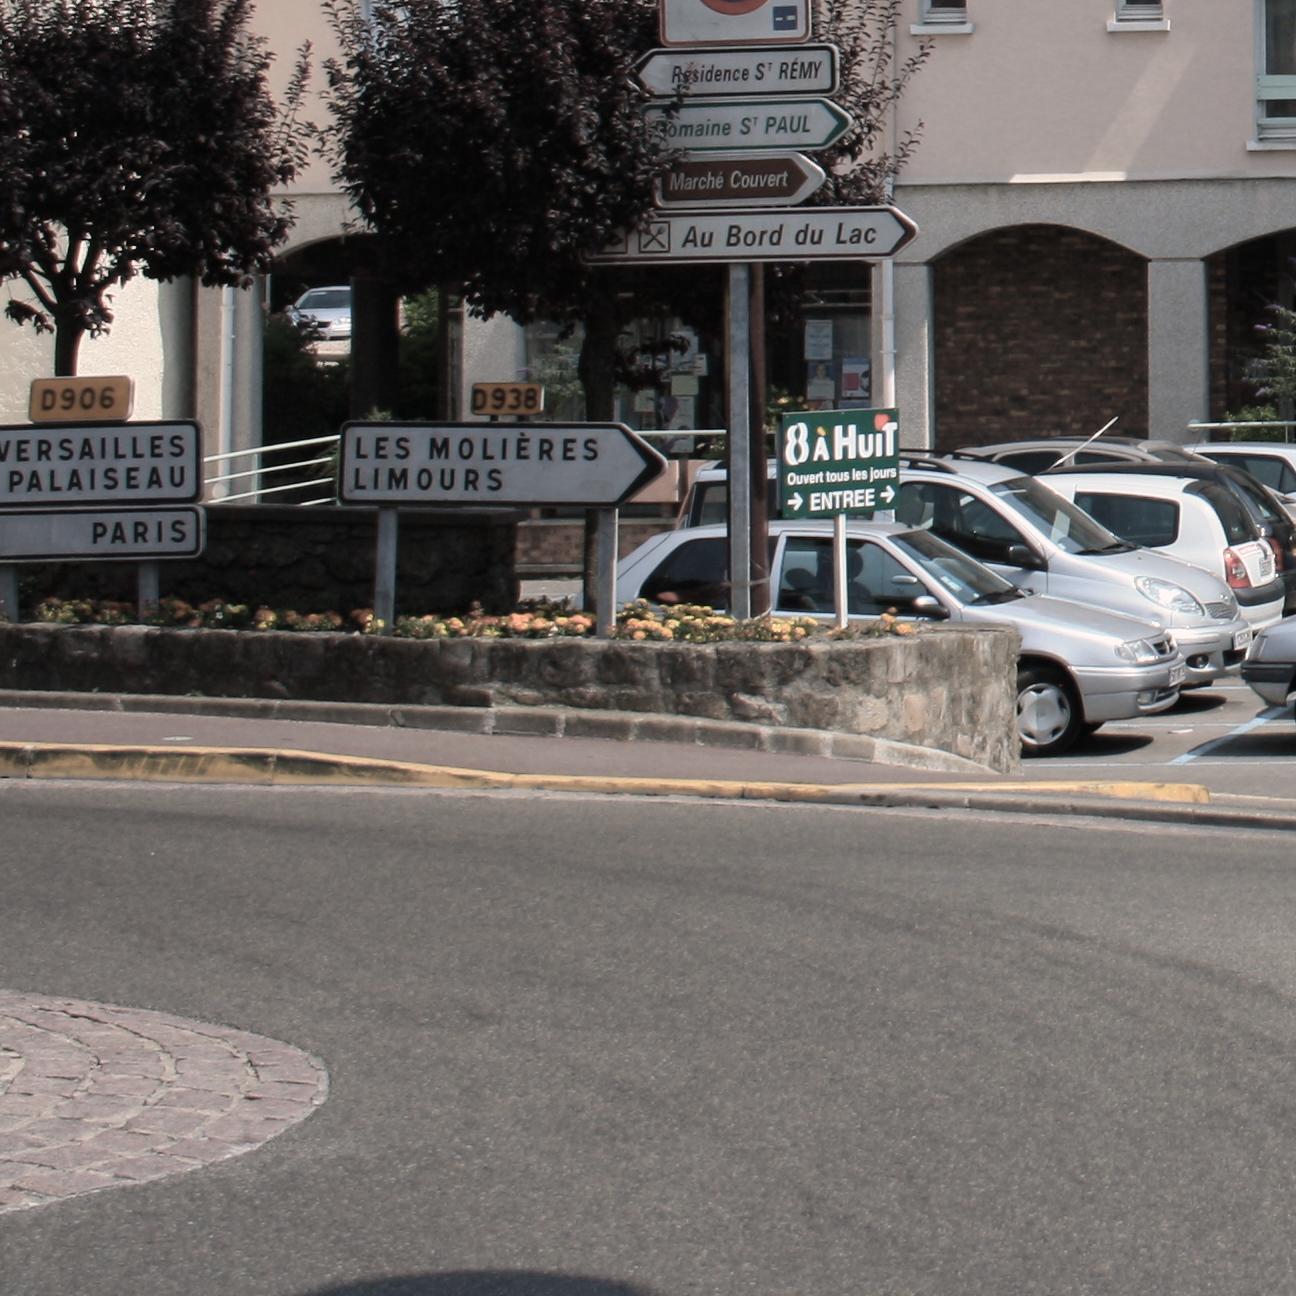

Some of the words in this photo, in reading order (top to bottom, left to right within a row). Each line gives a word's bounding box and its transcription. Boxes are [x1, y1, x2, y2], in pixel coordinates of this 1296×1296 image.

[779, 57, 822, 80] RÉMY
[655, 117, 731, 138] omaine
[765, 115, 811, 135] PAUL
[670, 171, 724, 190] Marché
[730, 170, 789, 188] Couvert
[682, 224, 713, 248] Au
[726, 223, 784, 247] Bord
[795, 223, 824, 245] du
[835, 222, 877, 245] Lac
[41, 387, 115, 411] D906
[473, 387, 537, 411] D938
[0, 435, 185, 462] VERSAILLES
[355, 436, 410, 460] LES
[429, 432, 599, 462] MOLIÈRES
[785, 422, 810, 465] 8
[9, 466, 185, 492] PALAISEAU
[354, 468, 503, 491] LIMOURS
[787, 471, 824, 486] Ouvert
[826, 470, 850, 483] tous
[852, 468, 868, 481] les
[869, 467, 897, 483] jours
[810, 488, 875, 511] ENTREE
[92, 520, 187, 544] PARIS
